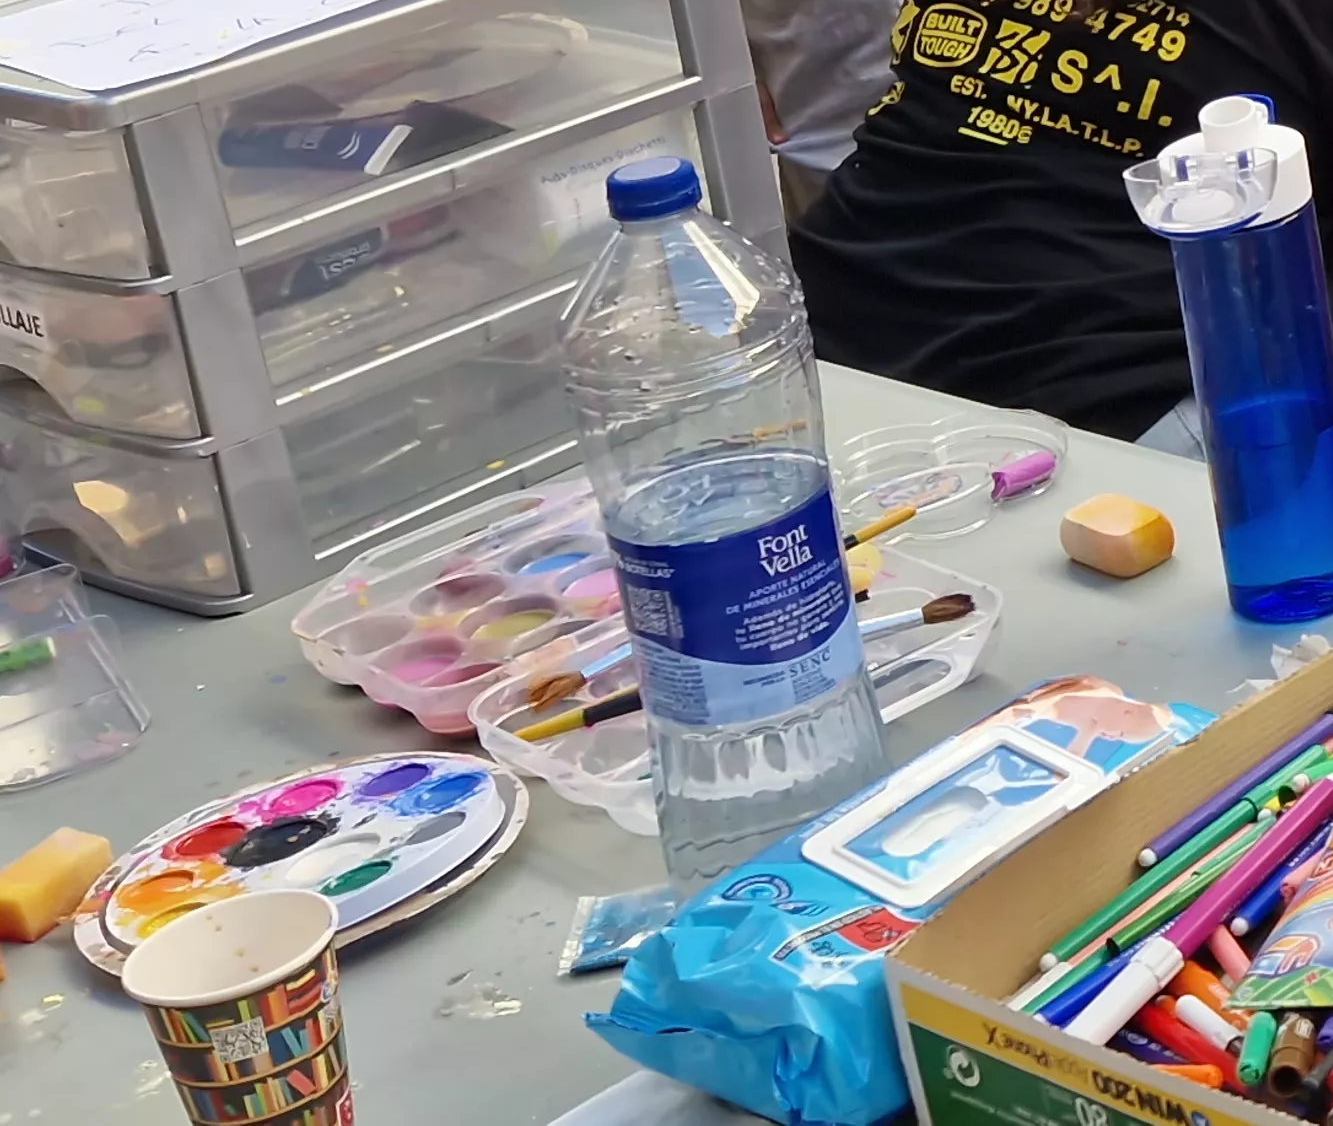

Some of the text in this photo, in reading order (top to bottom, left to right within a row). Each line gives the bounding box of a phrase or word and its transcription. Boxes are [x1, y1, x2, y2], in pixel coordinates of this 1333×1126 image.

[925, 12, 983, 36] BUILT
[1084, 8, 1187, 62] 4749
[919, 36, 970, 59] TOUGH
[950, 74, 987, 100] EST.
[757, 524, 809, 559] Font
[760, 544, 814, 577] Vella
[725, 604, 741, 615] DE
[743, 584, 800, 612] MINERALES
[748, 578, 790, 600] APORTE
